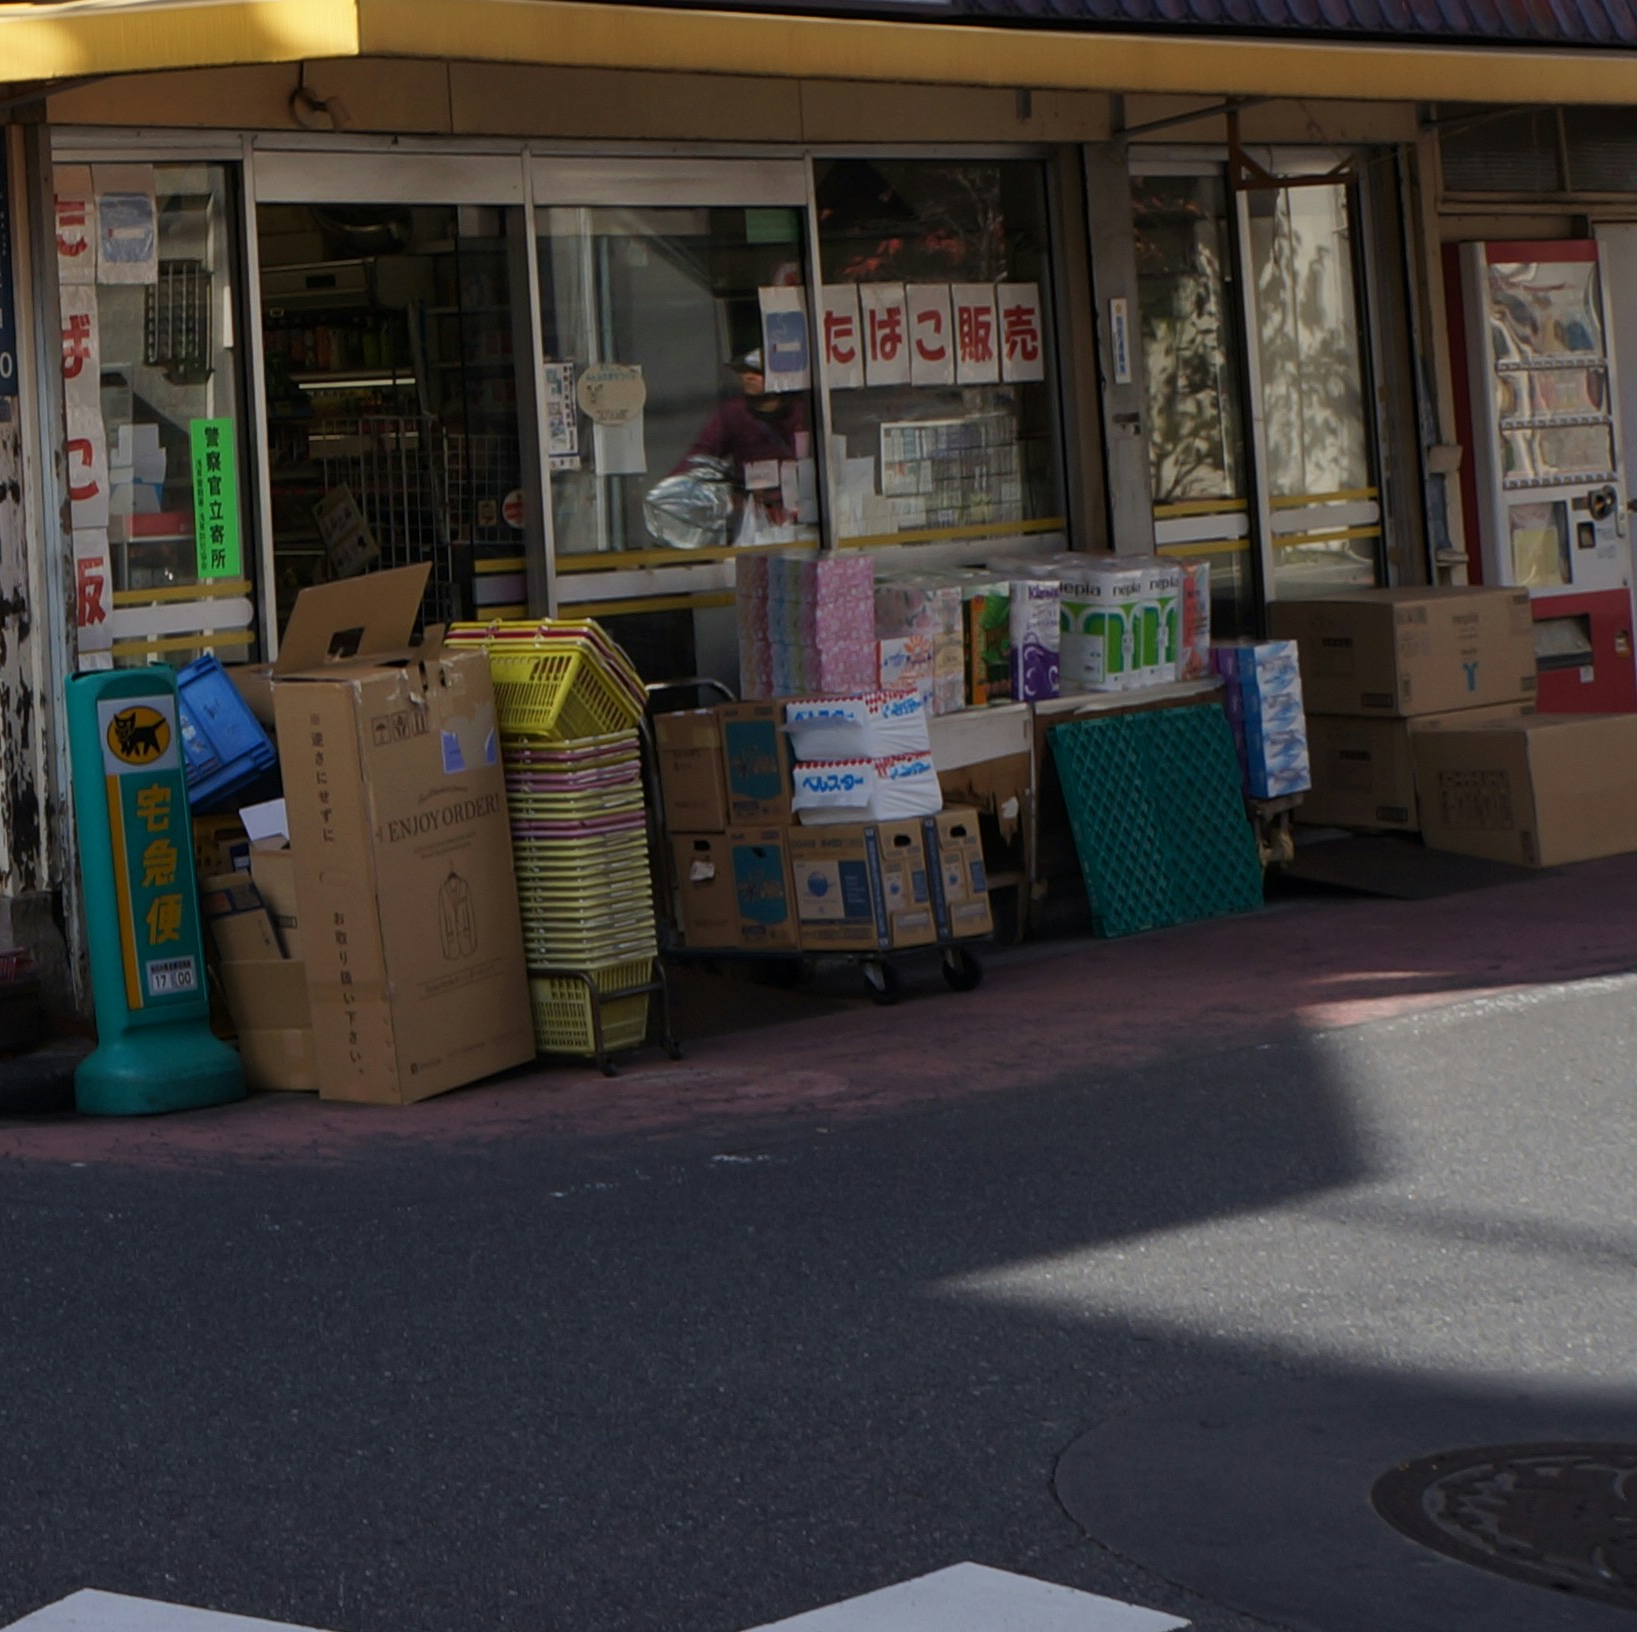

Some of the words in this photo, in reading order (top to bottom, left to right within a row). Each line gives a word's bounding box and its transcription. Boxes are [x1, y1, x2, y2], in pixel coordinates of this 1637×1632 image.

[823, 302, 1041, 366] たばこ販売
[203, 426, 226, 570] 警察官立寄所
[1112, 580, 1142, 597] nepia
[388, 808, 440, 843] ENJOY
[441, 791, 501, 827] ORDER!
[135, 782, 183, 946] 宅急便
[155, 973, 167, 989] 17
[177, 970, 192, 985] 00
